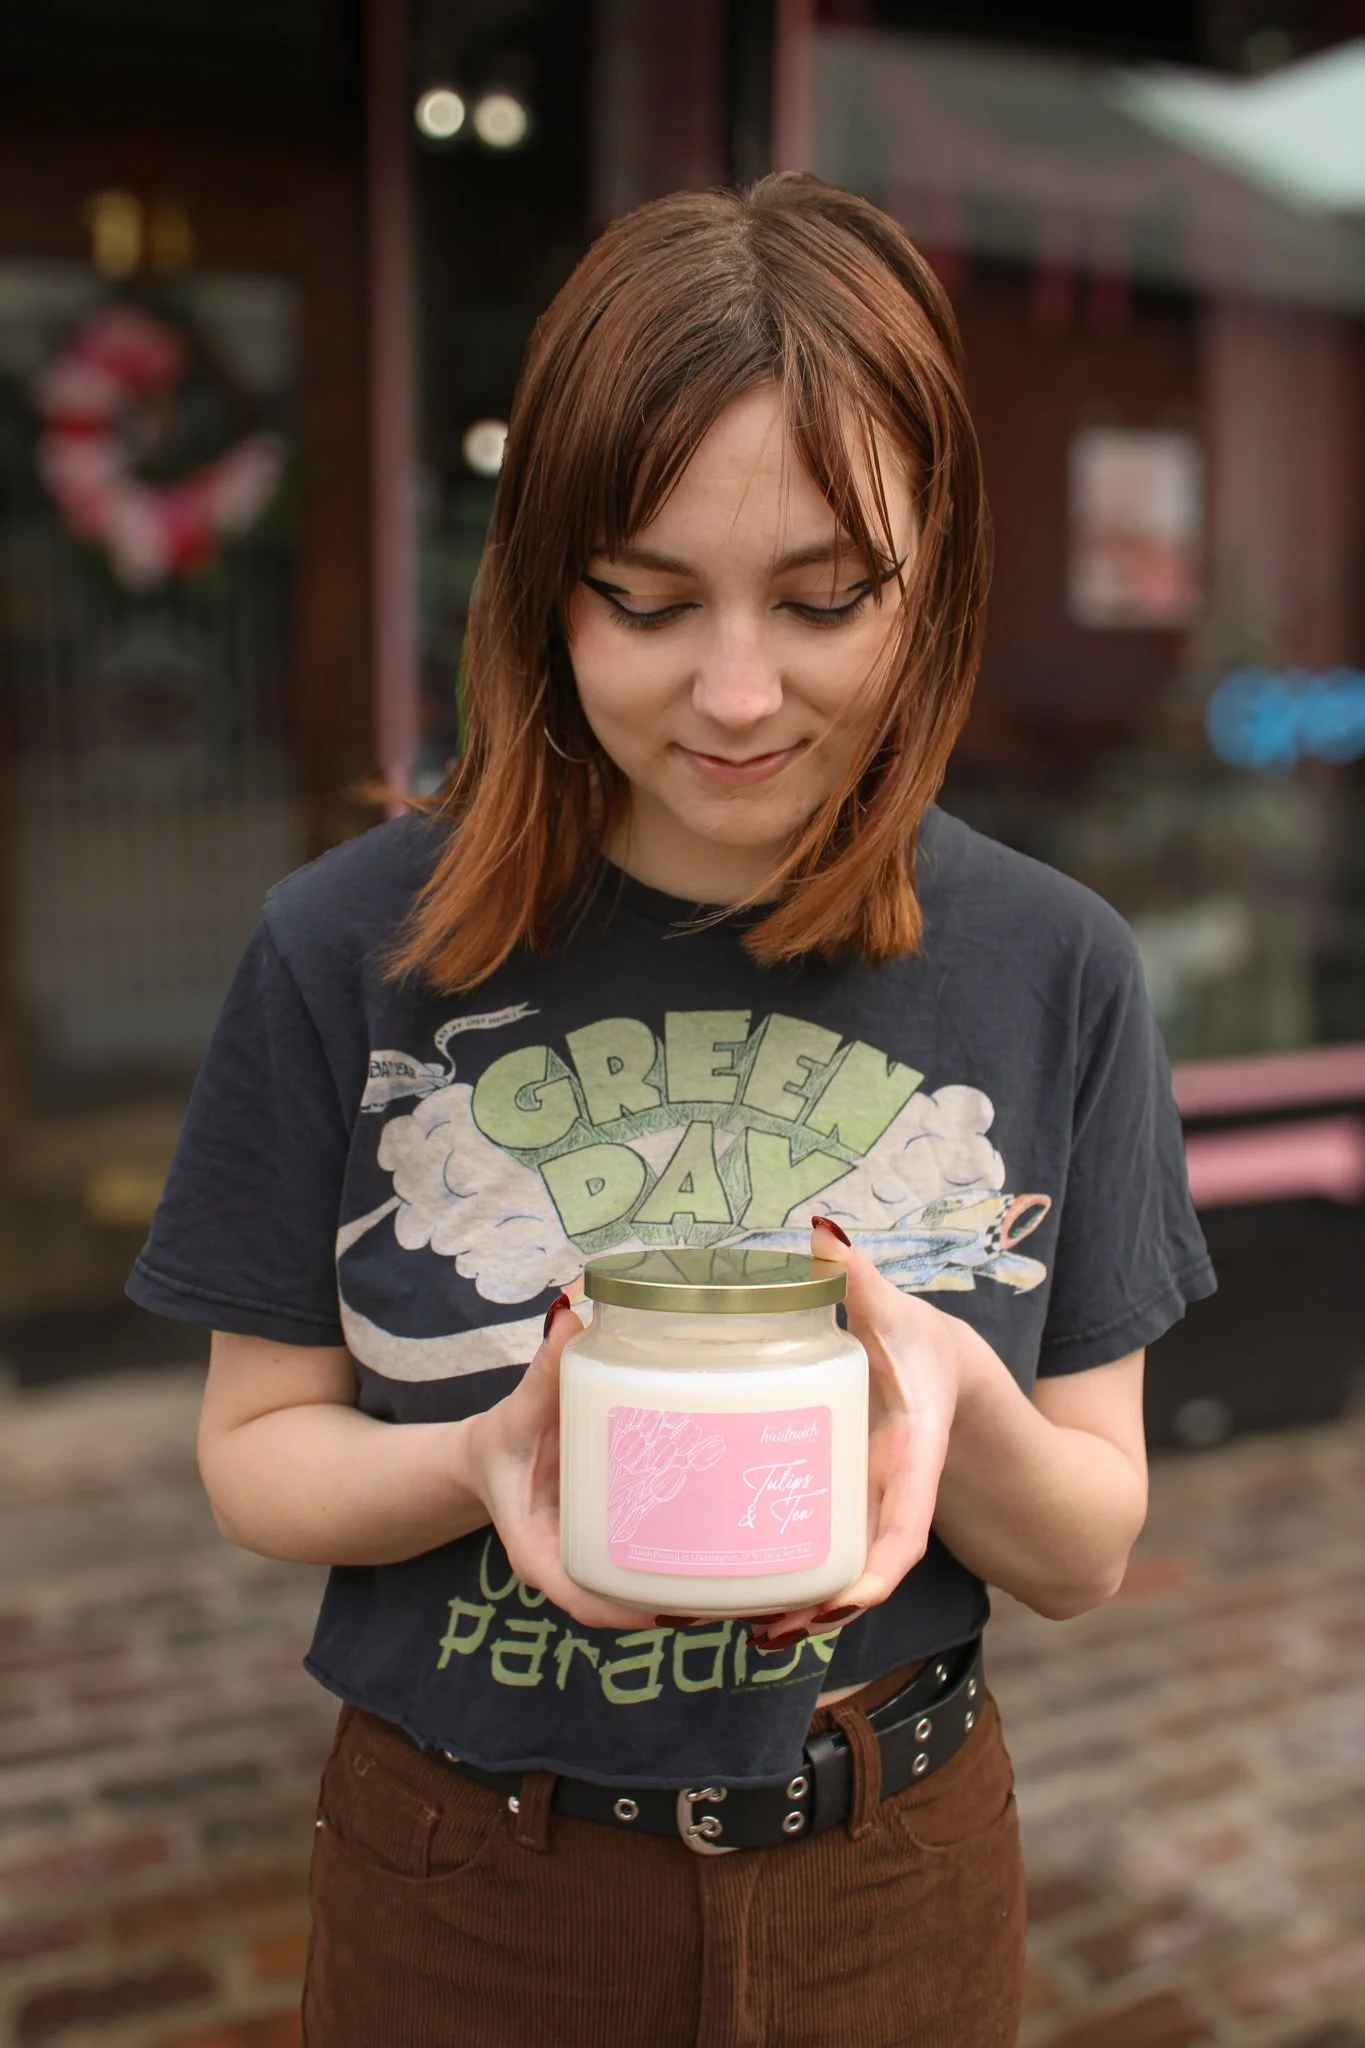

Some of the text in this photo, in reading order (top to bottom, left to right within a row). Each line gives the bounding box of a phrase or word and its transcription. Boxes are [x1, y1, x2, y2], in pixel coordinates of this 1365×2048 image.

[471, 1009, 925, 1158] GREEN
[537, 1119, 857, 1250] DAY
[737, 1487, 829, 1536] & Tea
[742, 1458, 815, 1505] Tulips
